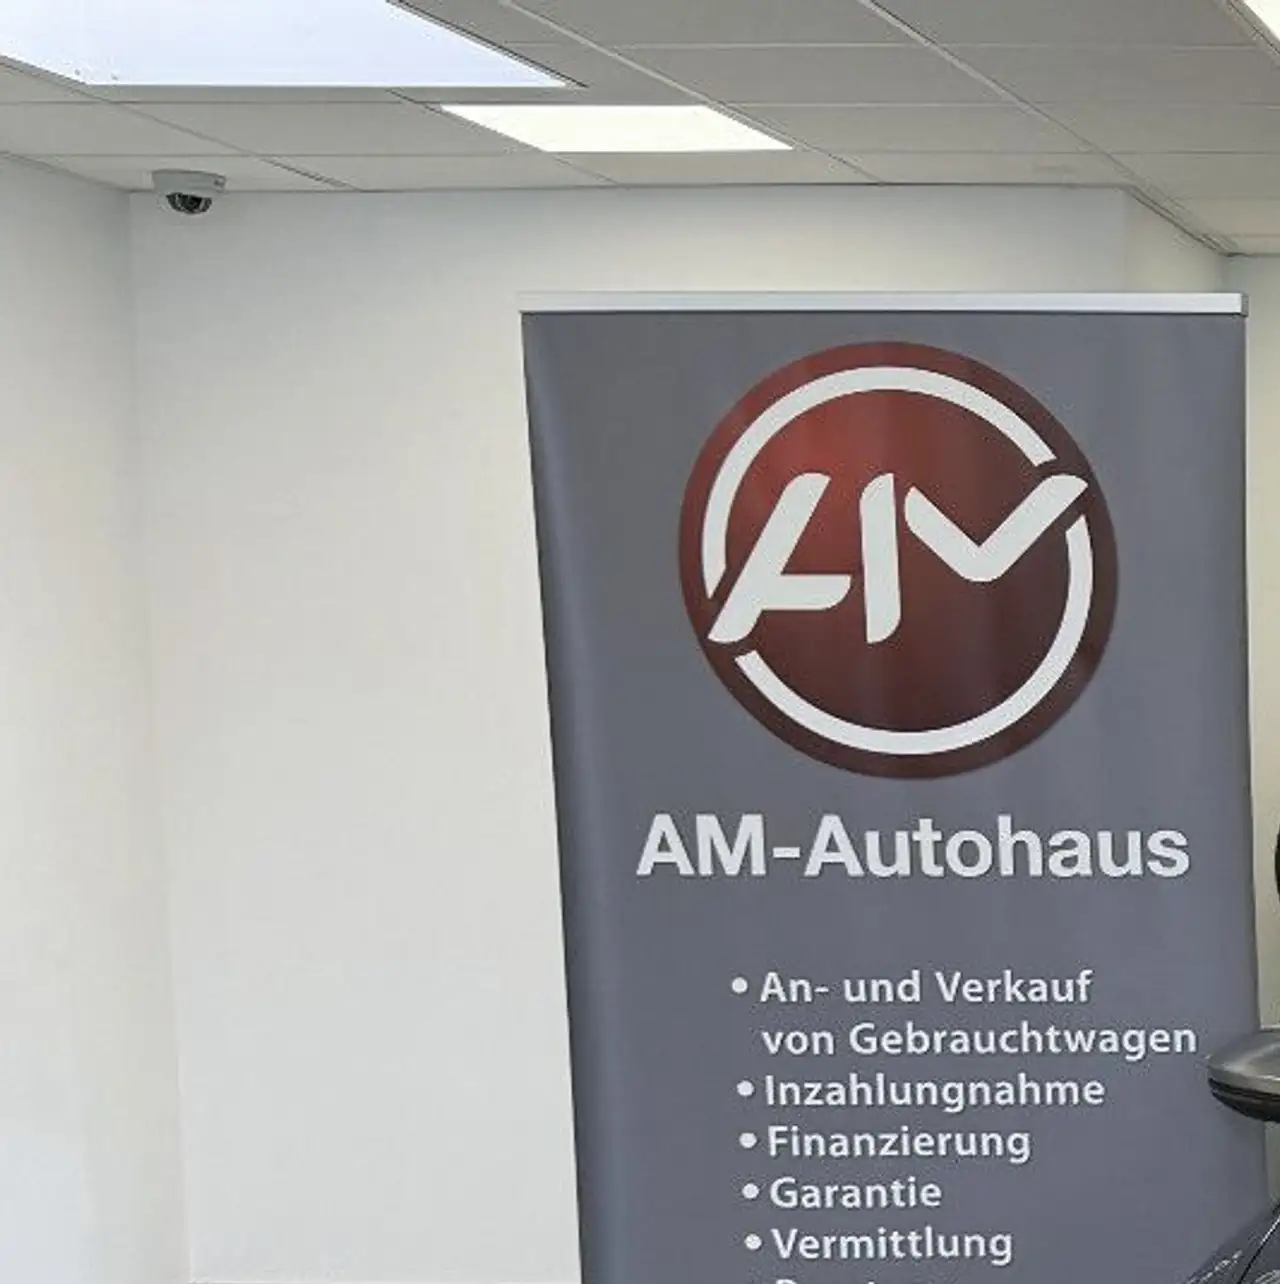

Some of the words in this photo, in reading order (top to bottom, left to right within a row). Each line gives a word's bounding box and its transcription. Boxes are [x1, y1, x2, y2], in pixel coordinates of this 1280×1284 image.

[635, 812, 1190, 879] AM-Autohaus
[758, 970, 829, 1003] An-
[842, 968, 921, 1003] und
[933, 968, 1094, 1003] Verkauf
[761, 1029, 834, 1056] von
[848, 1019, 1197, 1062] Gebrauchtwagen
[764, 1071, 1105, 1114] Inzahlungnahme
[767, 1124, 1031, 1165] Finanzierung
[769, 1175, 943, 1209] Garantie
[771, 1224, 1013, 1267] Vermittlung
